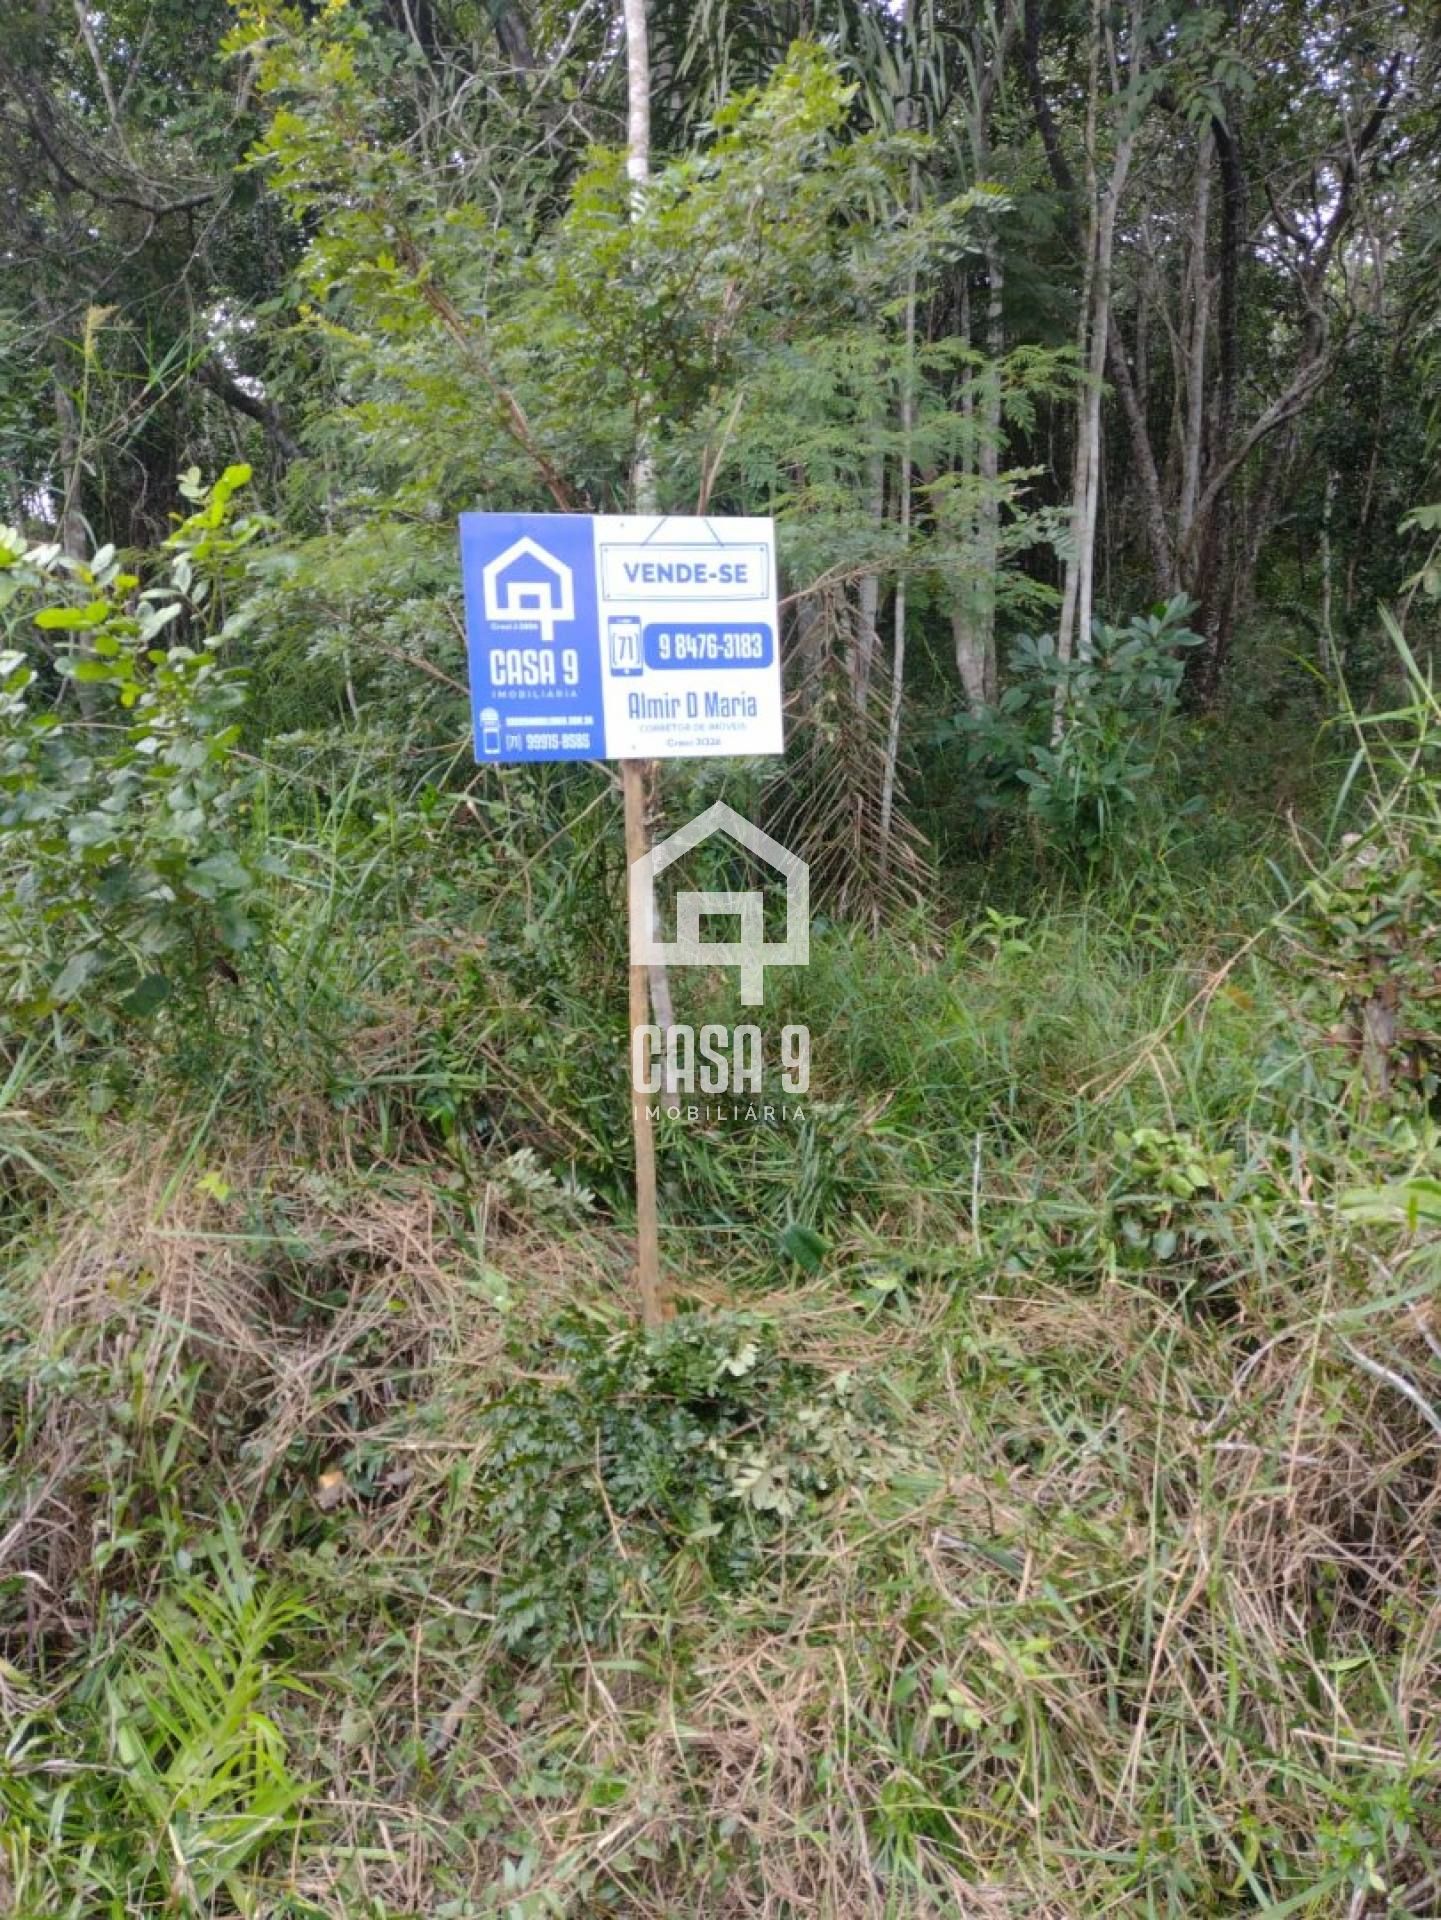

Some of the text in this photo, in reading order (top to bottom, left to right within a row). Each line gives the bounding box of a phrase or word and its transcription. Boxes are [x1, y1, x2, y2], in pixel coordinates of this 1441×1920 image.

[623, 563, 748, 583] VENDE-SE
[658, 632, 671, 661] 9
[674, 631, 763, 660] 8476-3183
[489, 648, 579, 686] CASA 9
[628, 690, 758, 719] Almir D Maria
